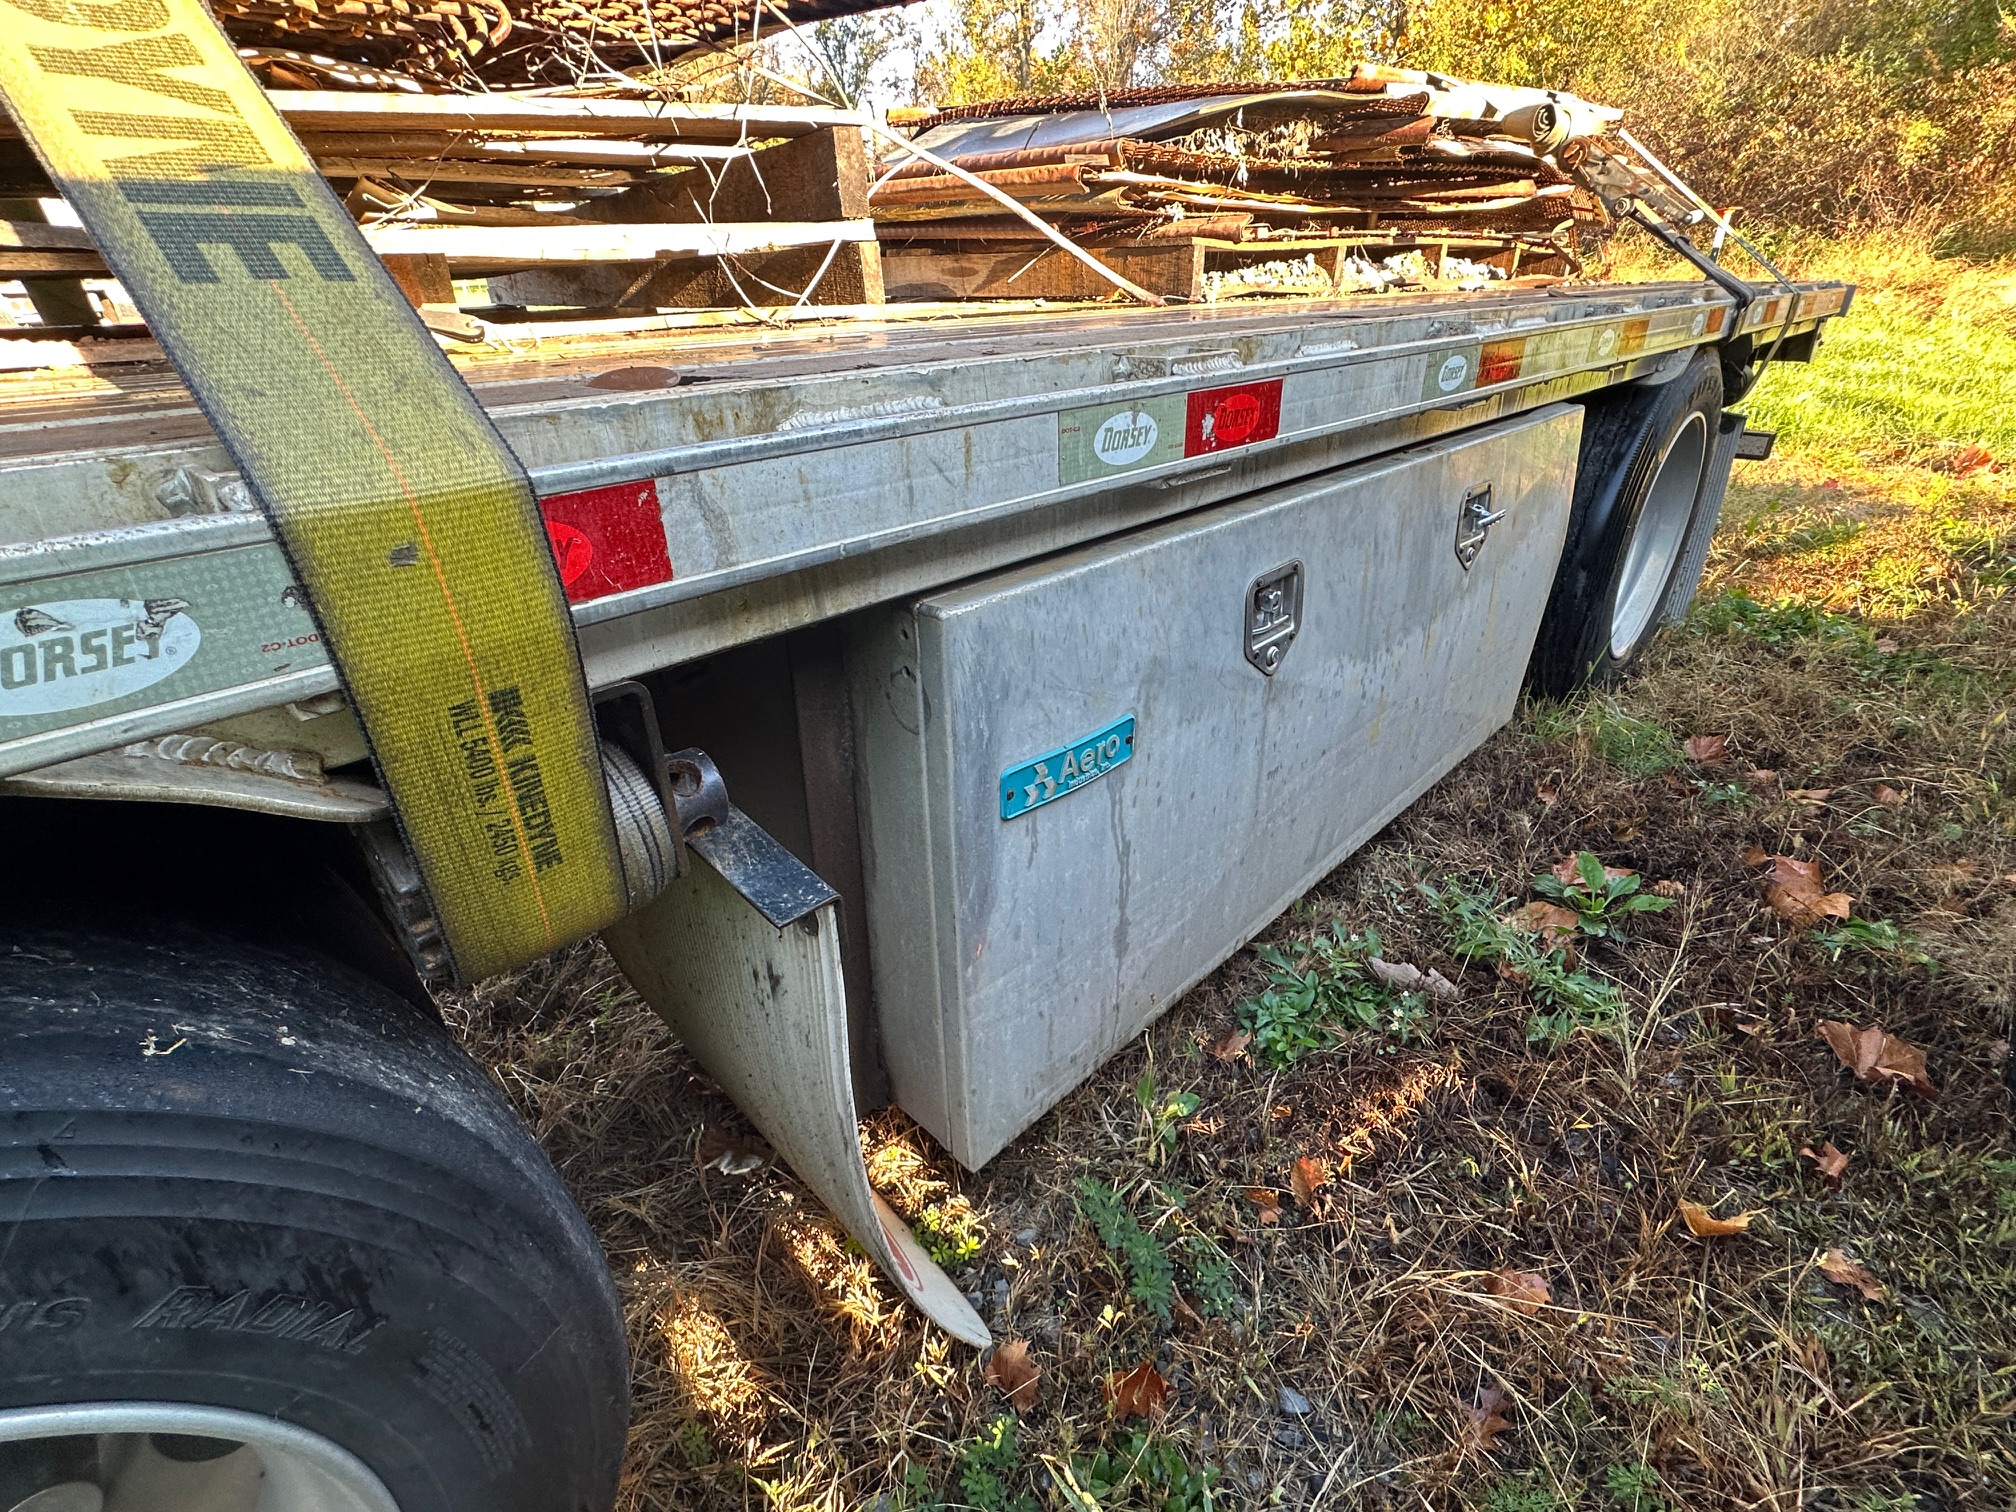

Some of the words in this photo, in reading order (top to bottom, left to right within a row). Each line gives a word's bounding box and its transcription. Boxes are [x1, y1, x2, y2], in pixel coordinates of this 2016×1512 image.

[1218, 405, 1257, 430] DORSEY
[1101, 424, 1153, 453] DORSEY
[261, 633, 319, 653] DOT-C2
[448, 698, 483, 739] WLL
[459, 736, 496, 780] 5400
[1058, 734, 1120, 784] Aero
[473, 776, 501, 808] lbs.
[507, 753, 564, 874] KINEDYNE
[485, 818, 520, 857] 2450
[494, 854, 523, 887] kgs.
[132, 1285, 389, 1356] RADIAL
